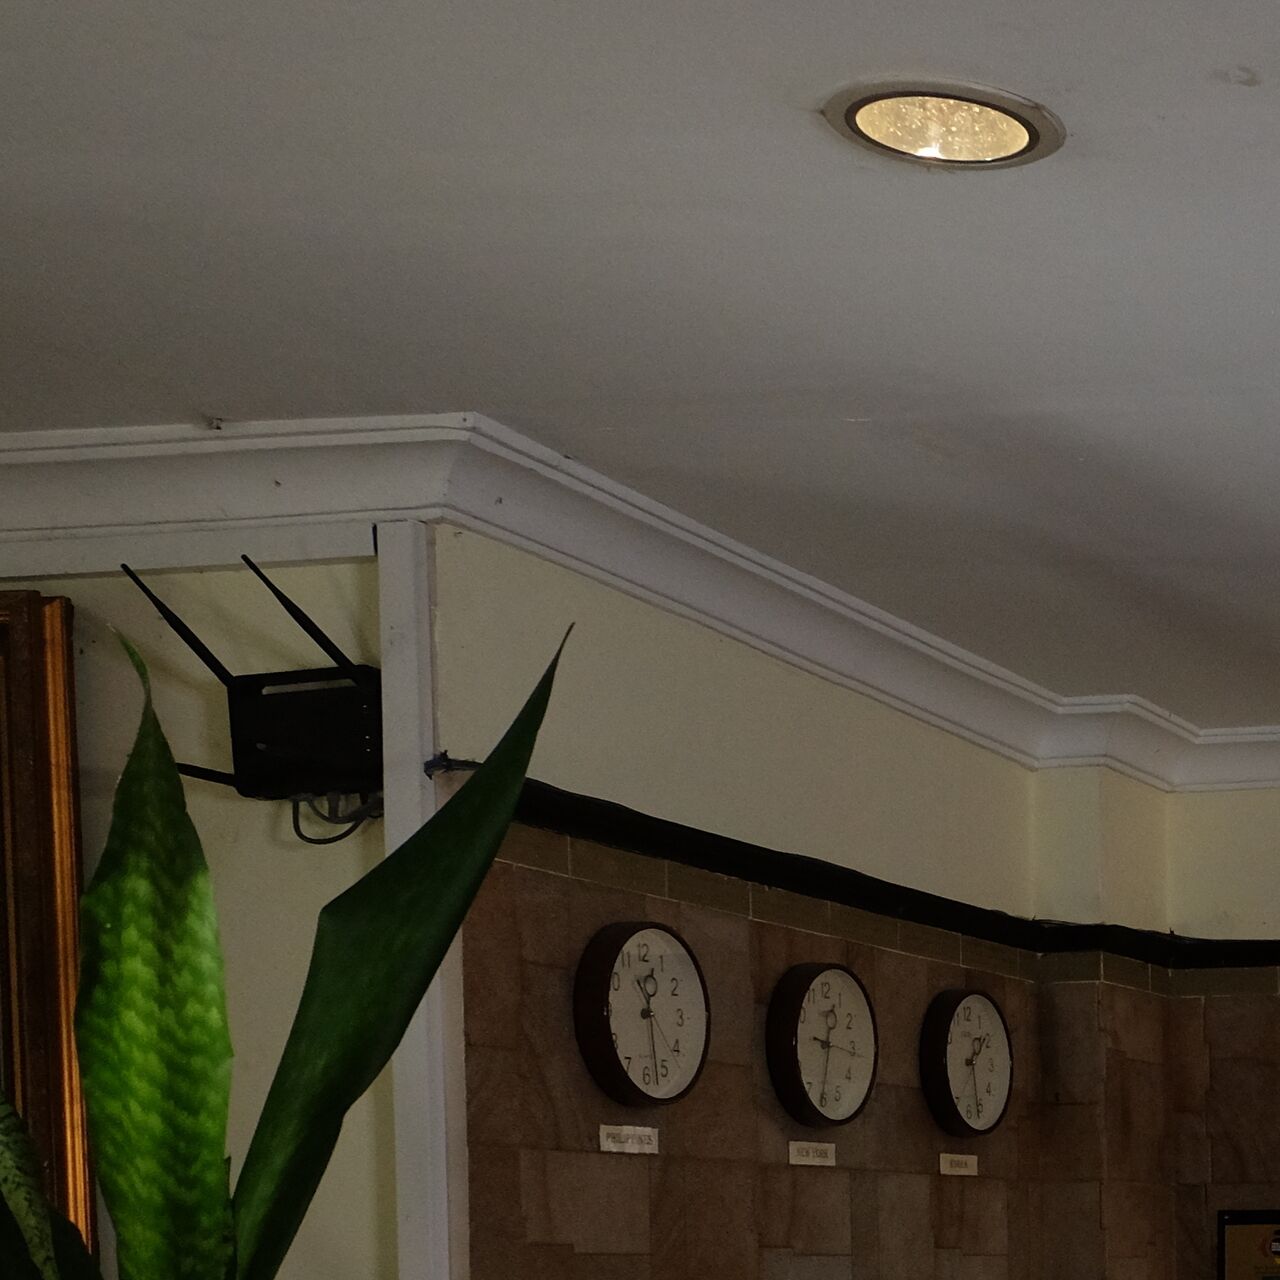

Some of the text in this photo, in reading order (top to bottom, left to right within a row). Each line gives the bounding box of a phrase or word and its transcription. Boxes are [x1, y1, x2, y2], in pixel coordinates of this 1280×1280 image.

[638, 943, 650, 963] 12
[659, 955, 664, 972] 1
[671, 977, 679, 996] 2
[821, 982, 830, 999] 12
[676, 1008, 684, 1027] 3
[963, 1006, 972, 1022] 12
[673, 1039, 680, 1053] 4
[642, 1066, 650, 1085] 6
[660, 1059, 669, 1078] 5
